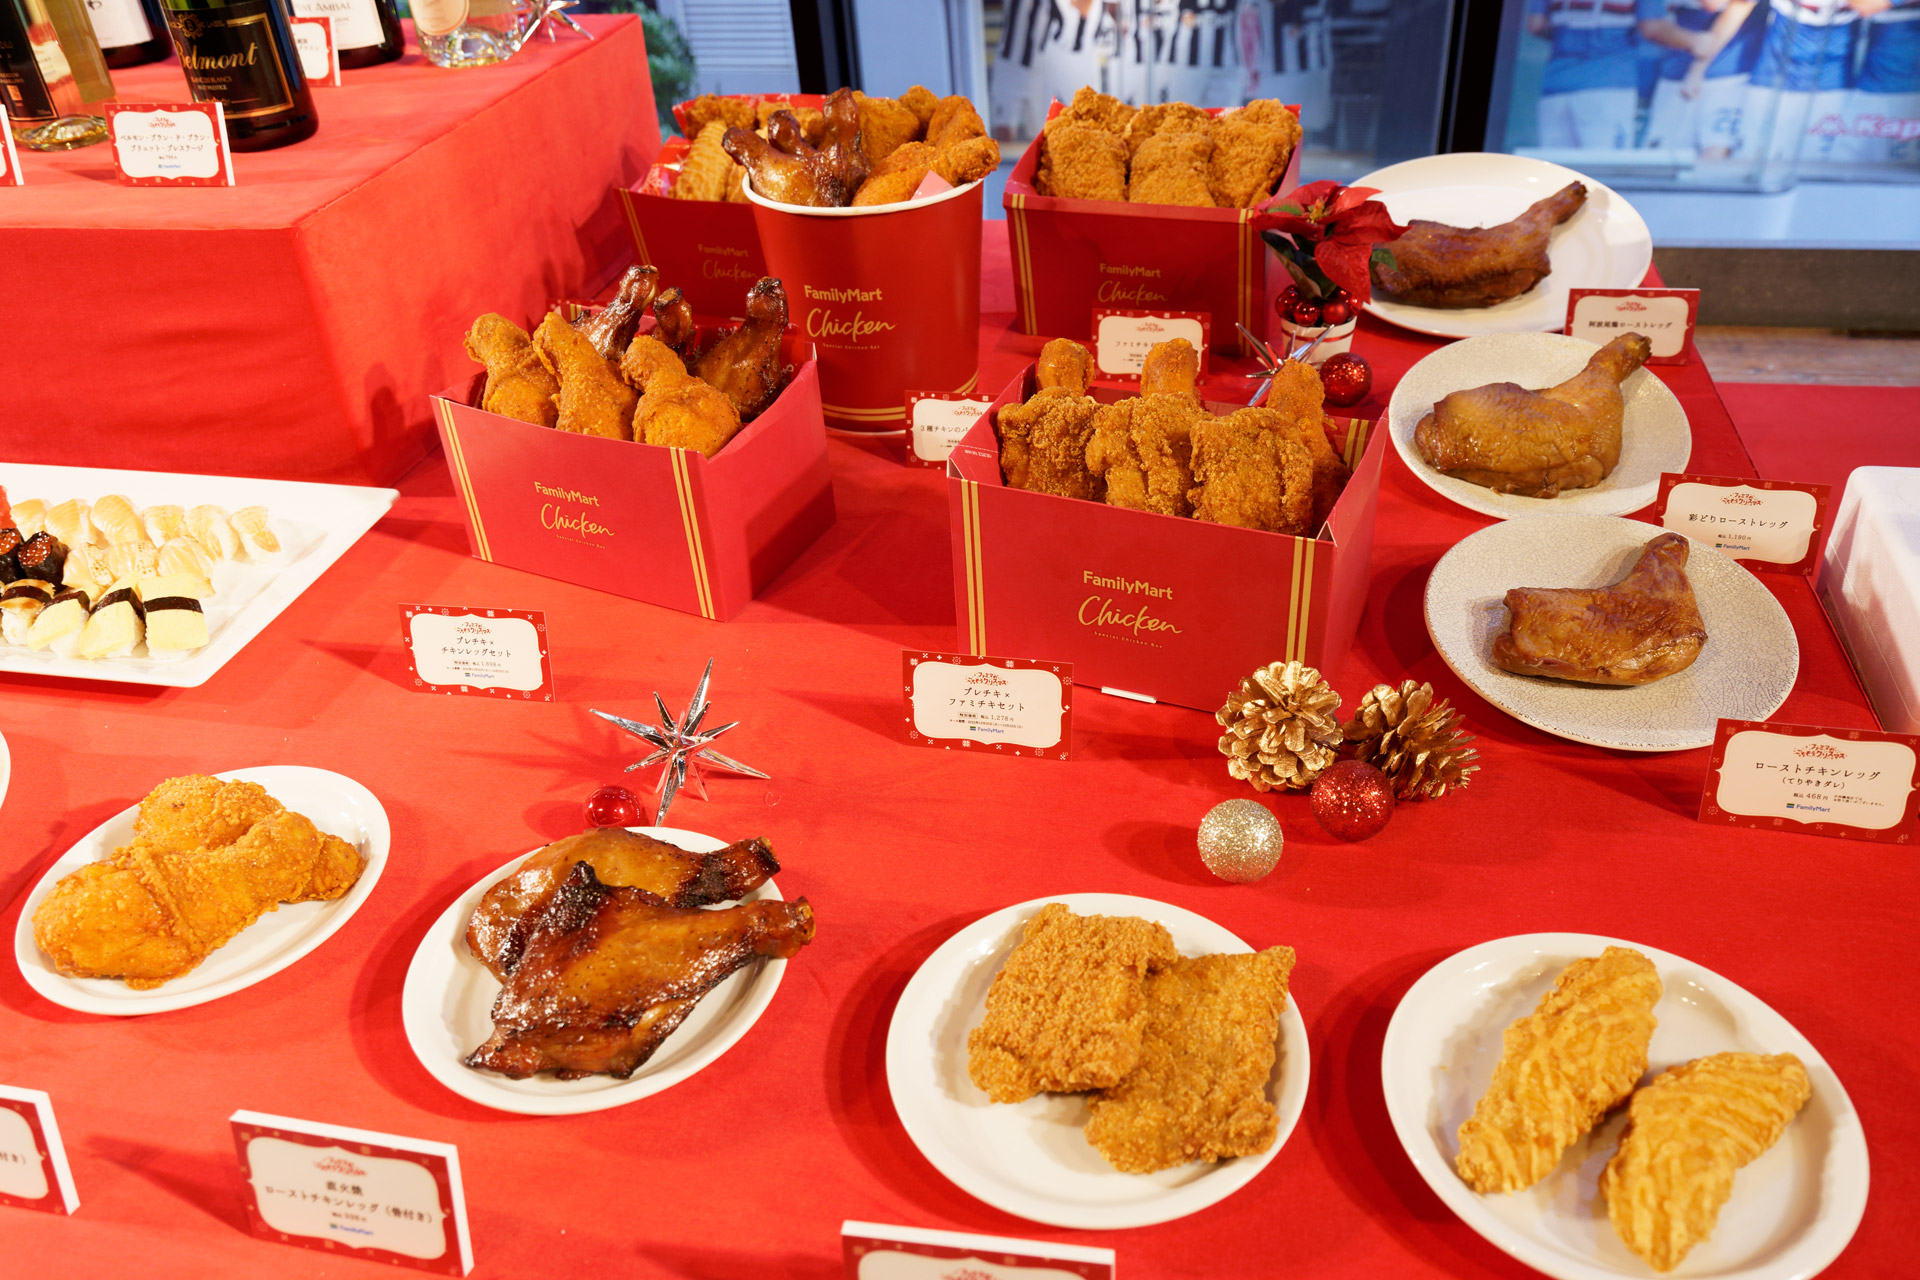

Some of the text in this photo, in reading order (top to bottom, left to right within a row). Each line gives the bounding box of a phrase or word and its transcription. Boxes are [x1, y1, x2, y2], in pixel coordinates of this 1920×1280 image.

[175, 40, 258, 70] Belmont
[698, 243, 749, 258] FamilyMart
[1100, 263, 1161, 277] FamilyMart
[804, 284, 883, 304] FamilyMart
[1097, 279, 1168, 306] Chicken
[806, 308, 898, 344] Chicken
[534, 481, 600, 507] FamilyMart
[541, 503, 615, 539] Chicken
[1688, 513, 1788, 529] 彩どりローストレッグ
[1722, 543, 1751, 551] FamilyMart
[1083, 570, 1173, 600] FamilyMart
[1078, 595, 1184, 637] Chicken
[441, 646, 512, 658] チキンレッグセット
[949, 698, 1025, 712] ファミチキセット
[977, 726, 1005, 734] FamilyMart
[1755, 762, 1881, 781] ローストチキンレッグ
[1795, 803, 1831, 813] FamilyMart
